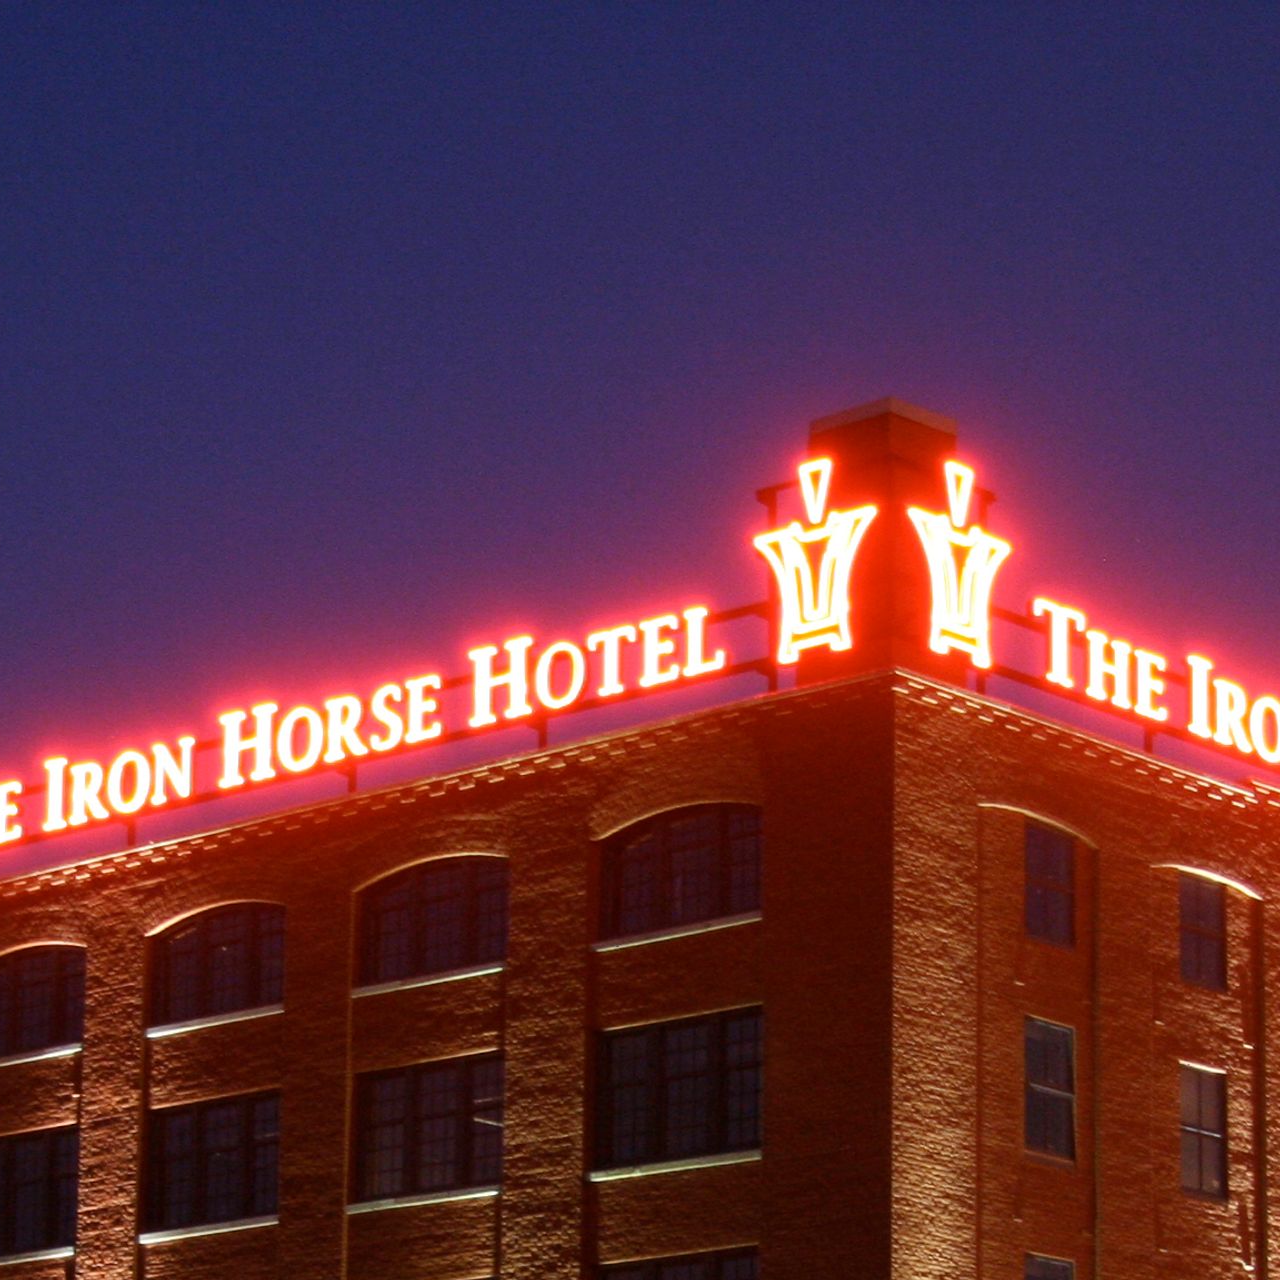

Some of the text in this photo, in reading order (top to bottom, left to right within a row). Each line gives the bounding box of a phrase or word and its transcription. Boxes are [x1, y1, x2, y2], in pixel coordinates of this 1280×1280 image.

[43, 736, 195, 831] IRON
[218, 674, 441, 788] HORSE
[468, 606, 724, 727] HOTEL
[1034, 598, 1168, 721] THE
